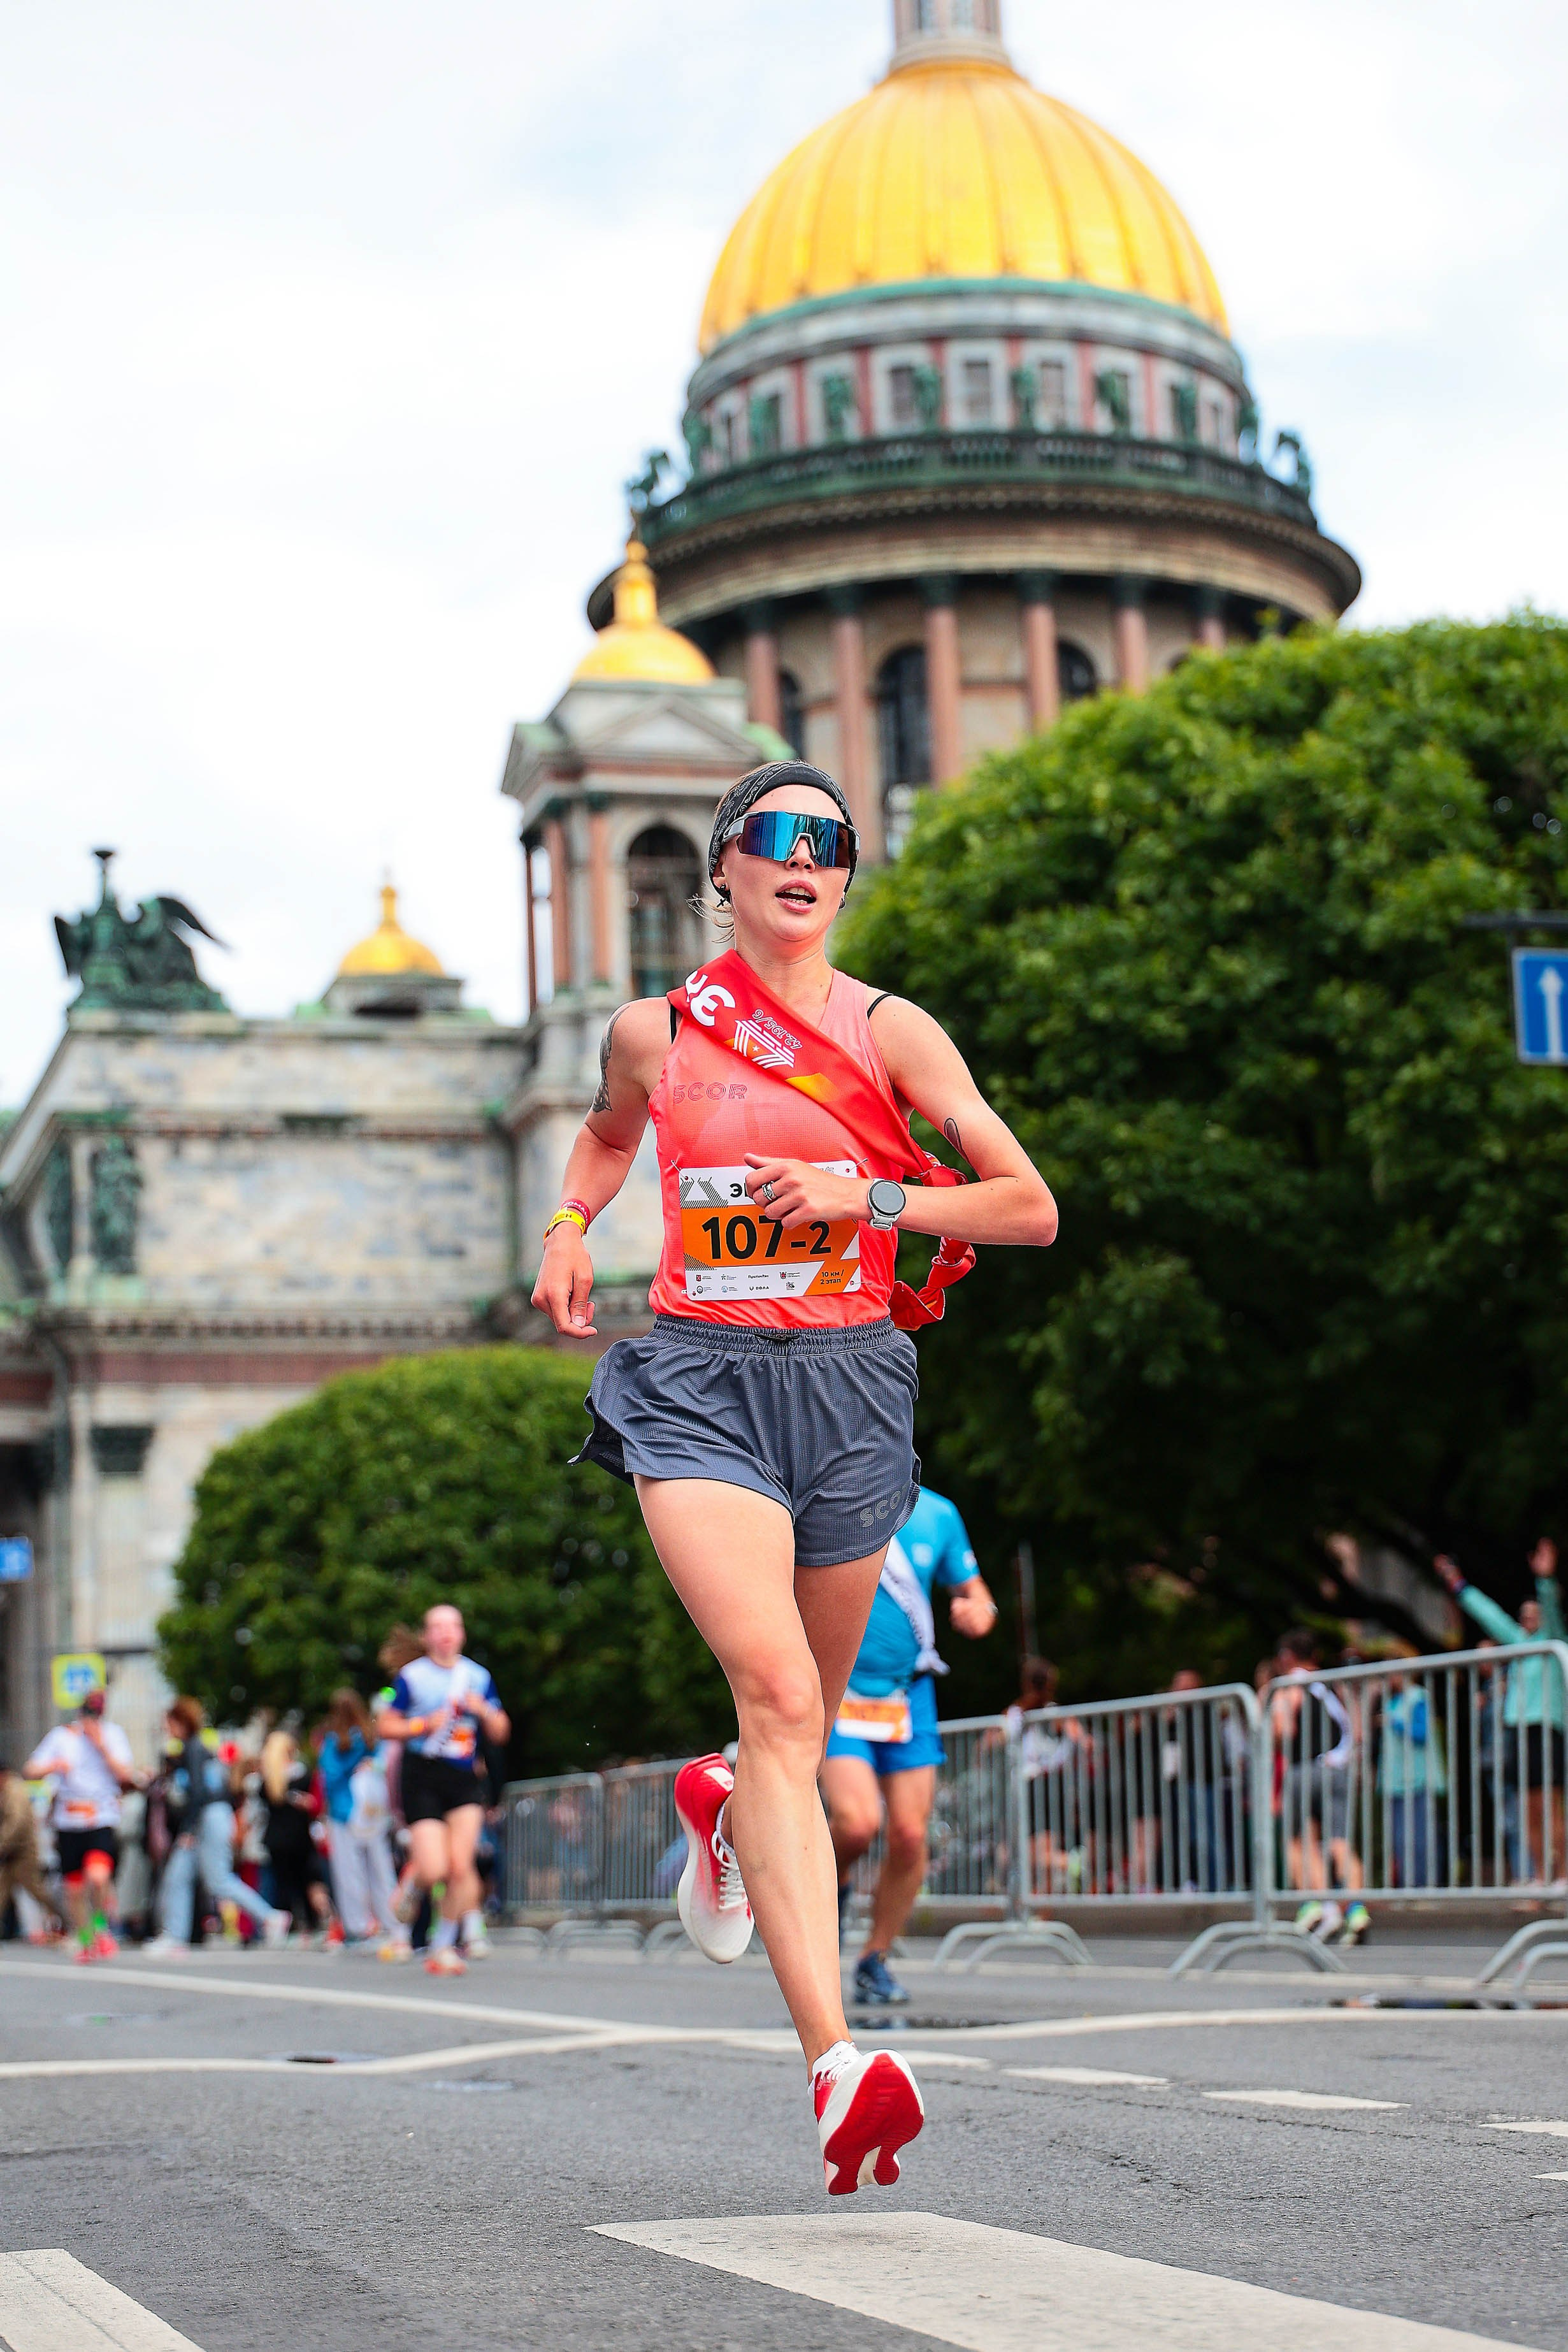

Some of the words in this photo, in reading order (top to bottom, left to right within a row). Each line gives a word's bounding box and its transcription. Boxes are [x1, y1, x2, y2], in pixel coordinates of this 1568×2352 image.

[752, 1009, 803, 1050] 42.195/6
[701, 1215, 831, 1260] 107-2
[860, 1482, 910, 1527] SCO
